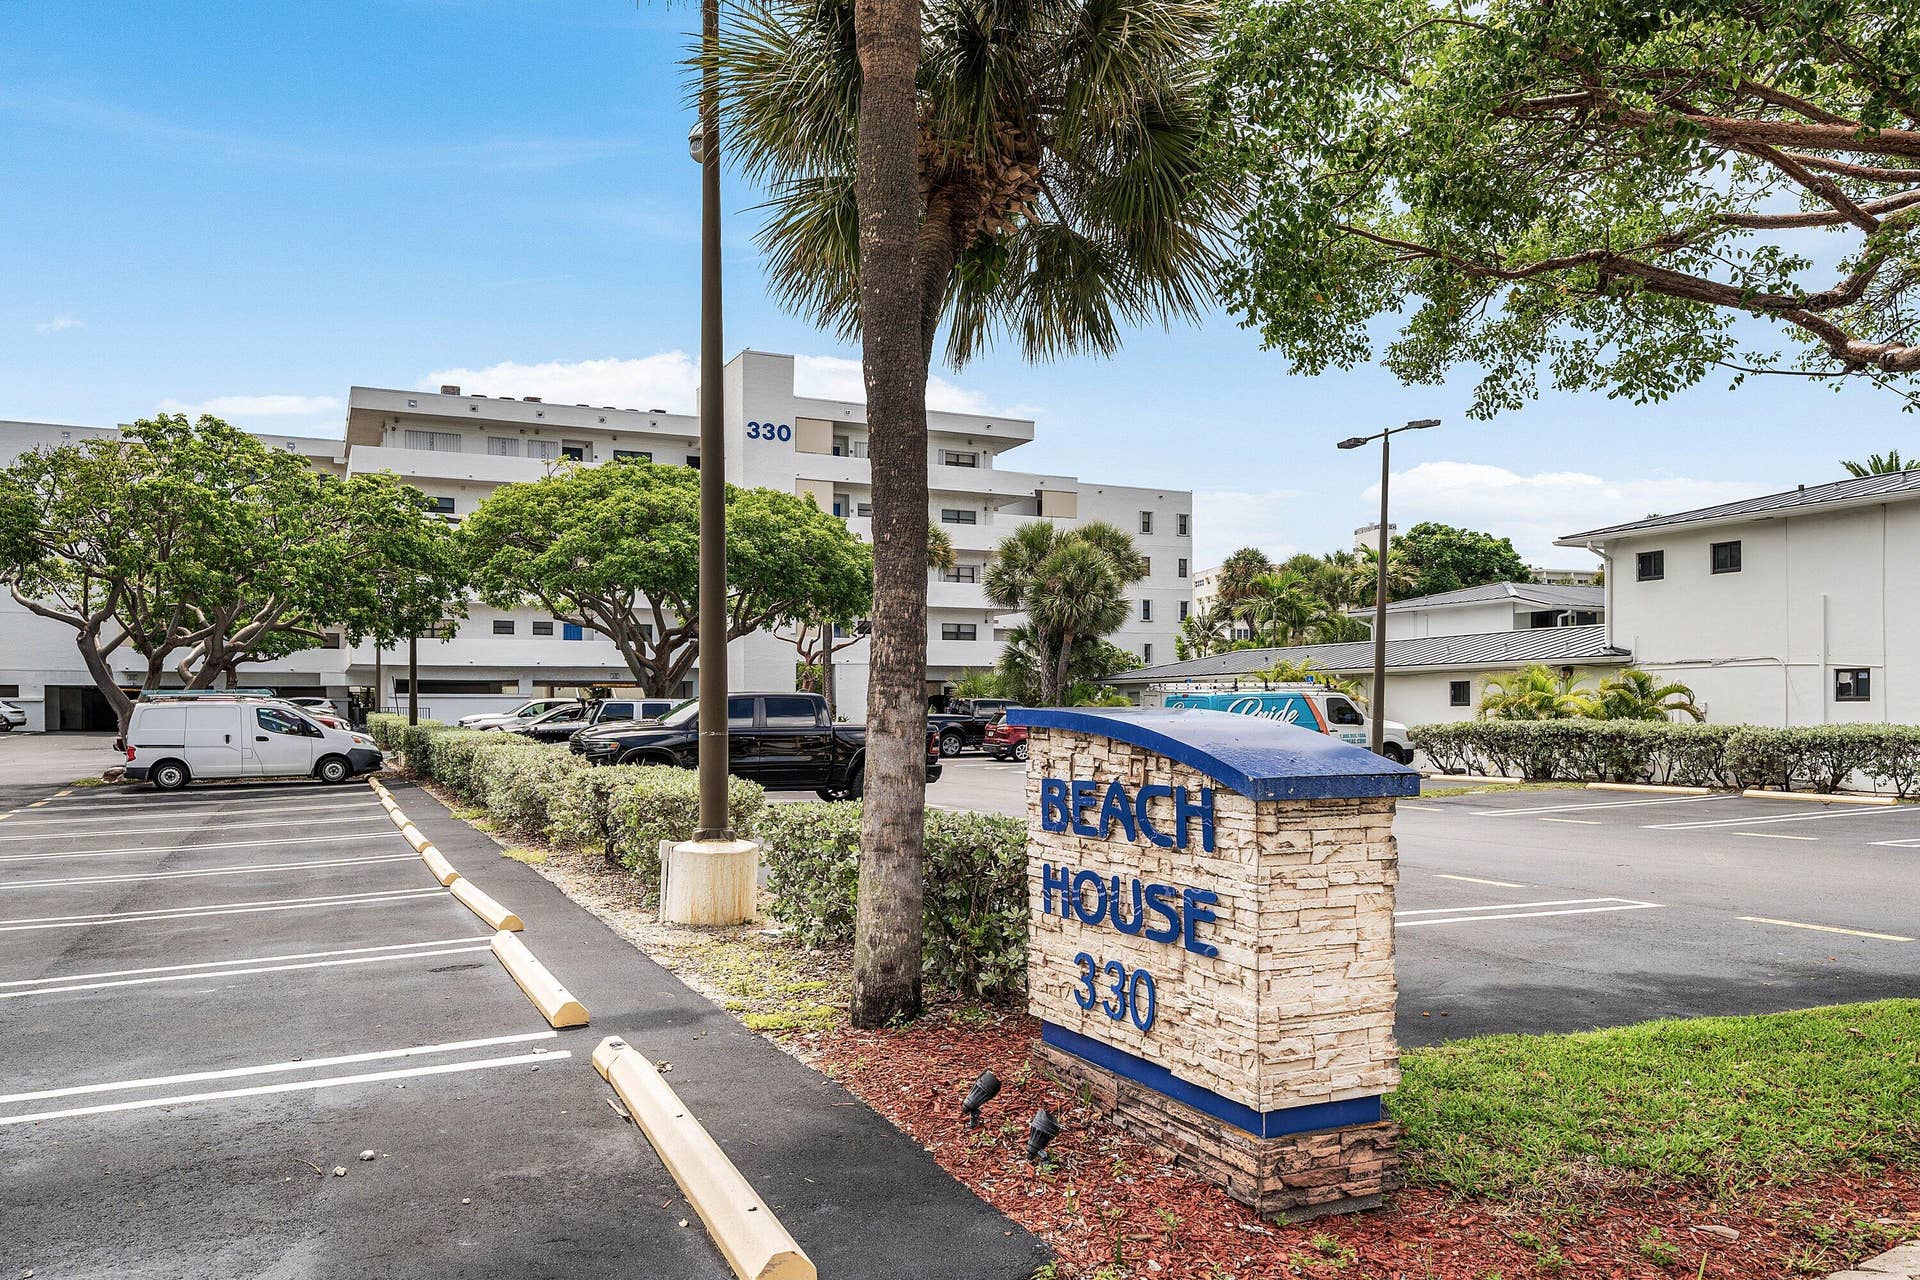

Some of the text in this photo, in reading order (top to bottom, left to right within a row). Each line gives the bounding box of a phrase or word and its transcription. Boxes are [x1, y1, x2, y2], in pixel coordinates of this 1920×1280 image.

[747, 421, 791, 442] 330
[1227, 697, 1300, 724] Pride
[1041, 777, 1215, 853] BEACH
[1042, 863, 1218, 958] HOUSE
[1073, 951, 1156, 1031] 330
